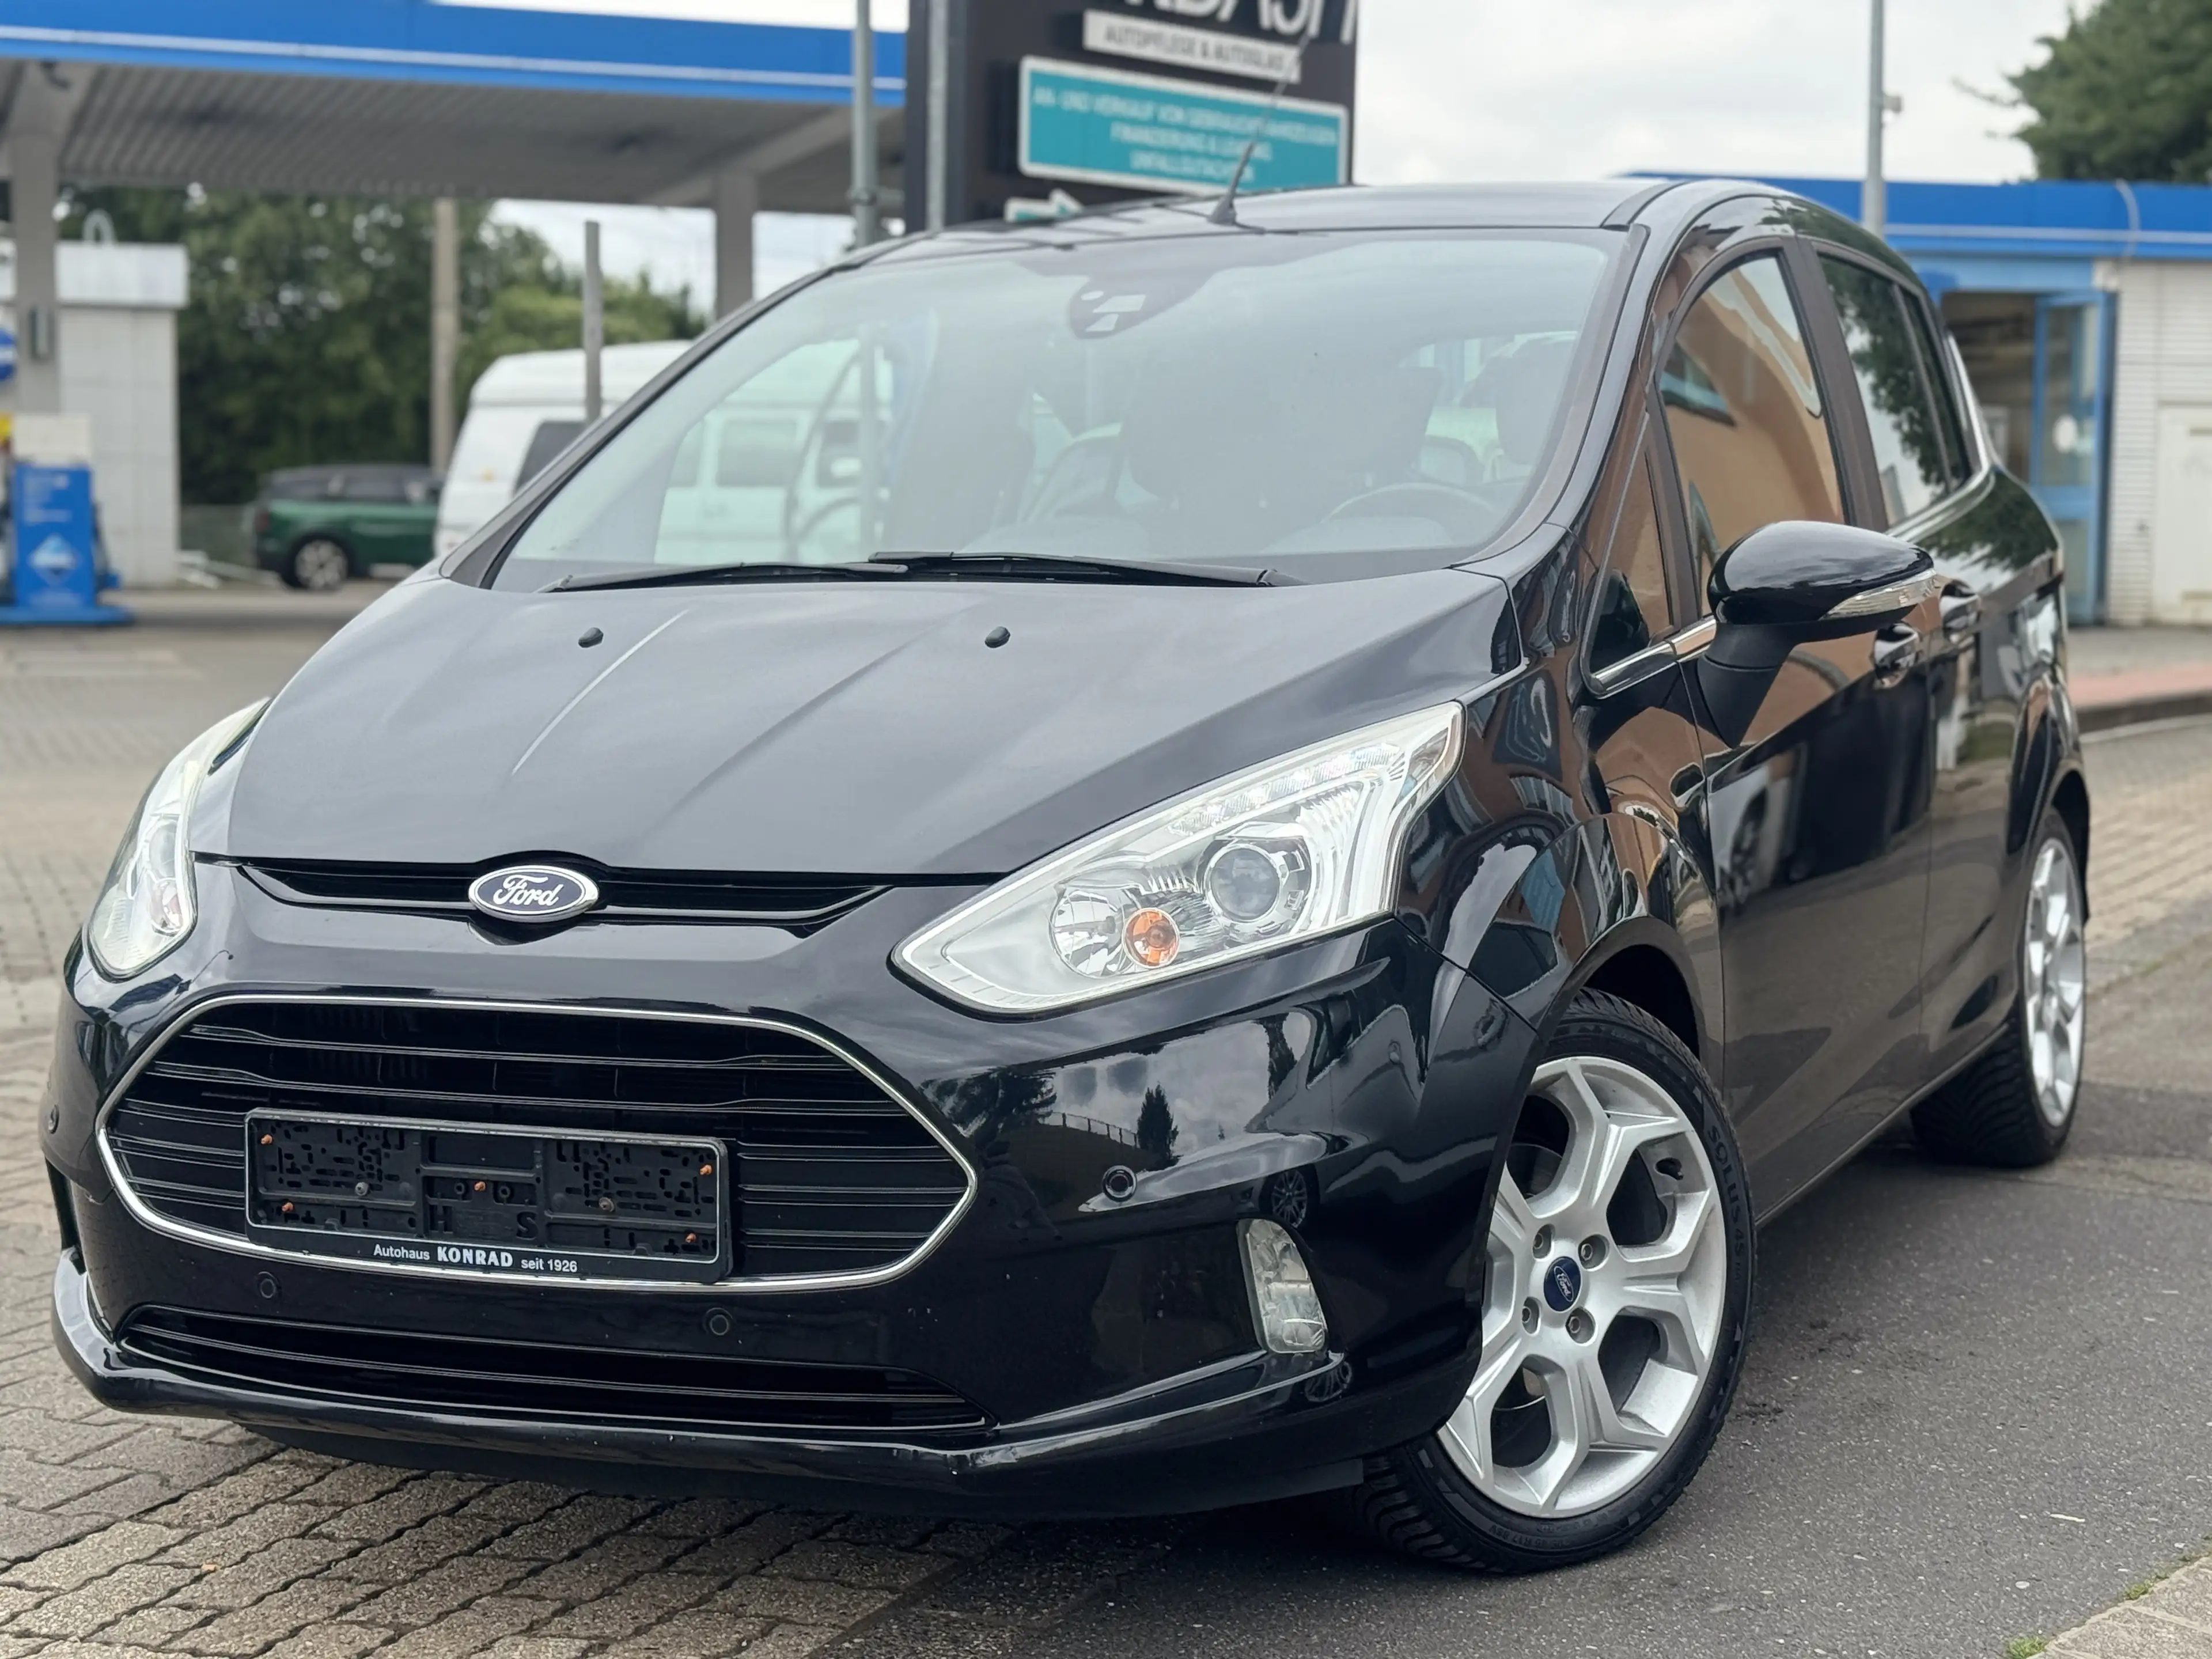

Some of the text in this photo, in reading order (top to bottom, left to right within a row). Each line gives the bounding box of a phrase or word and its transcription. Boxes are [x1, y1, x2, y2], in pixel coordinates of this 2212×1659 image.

[493, 874, 564, 906] Ford
[1708, 1125, 1740, 1224] SOLUS
[373, 1244, 578, 1274] Autohaus KONRAD seit 1926
[1556, 1272, 1572, 1297] Ford
